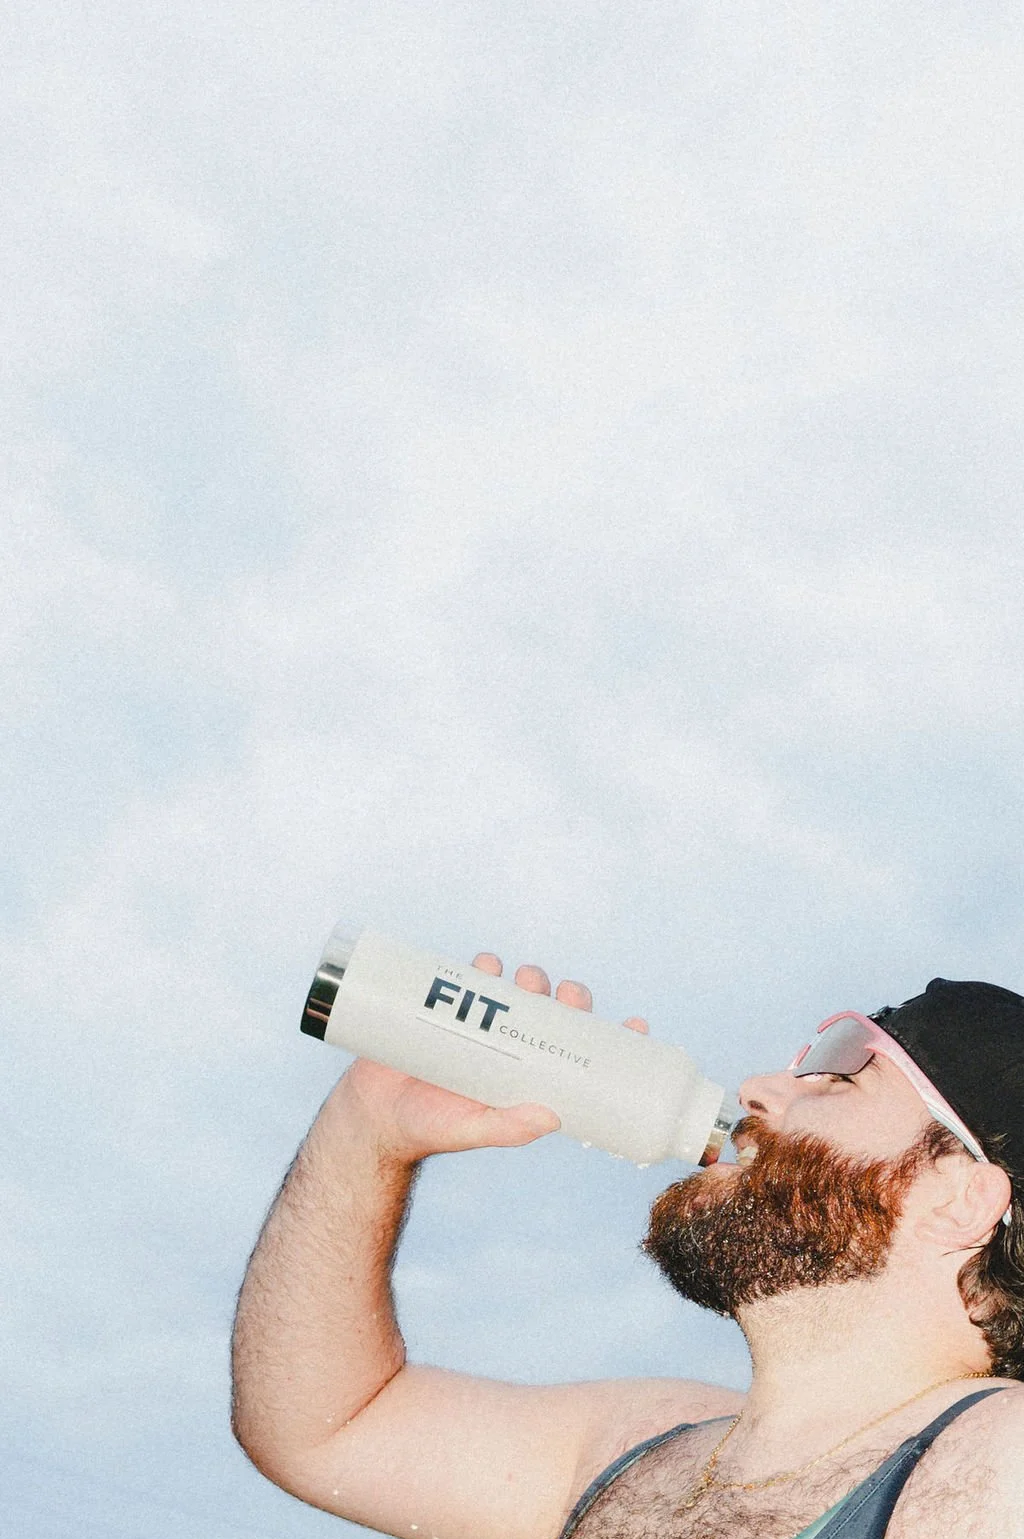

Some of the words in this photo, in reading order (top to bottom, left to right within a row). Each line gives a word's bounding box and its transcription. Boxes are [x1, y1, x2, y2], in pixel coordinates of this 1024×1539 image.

[437, 965, 463, 980] THE
[424, 976, 510, 1032] FIT
[499, 1025, 592, 1068] COLLECTIVE
